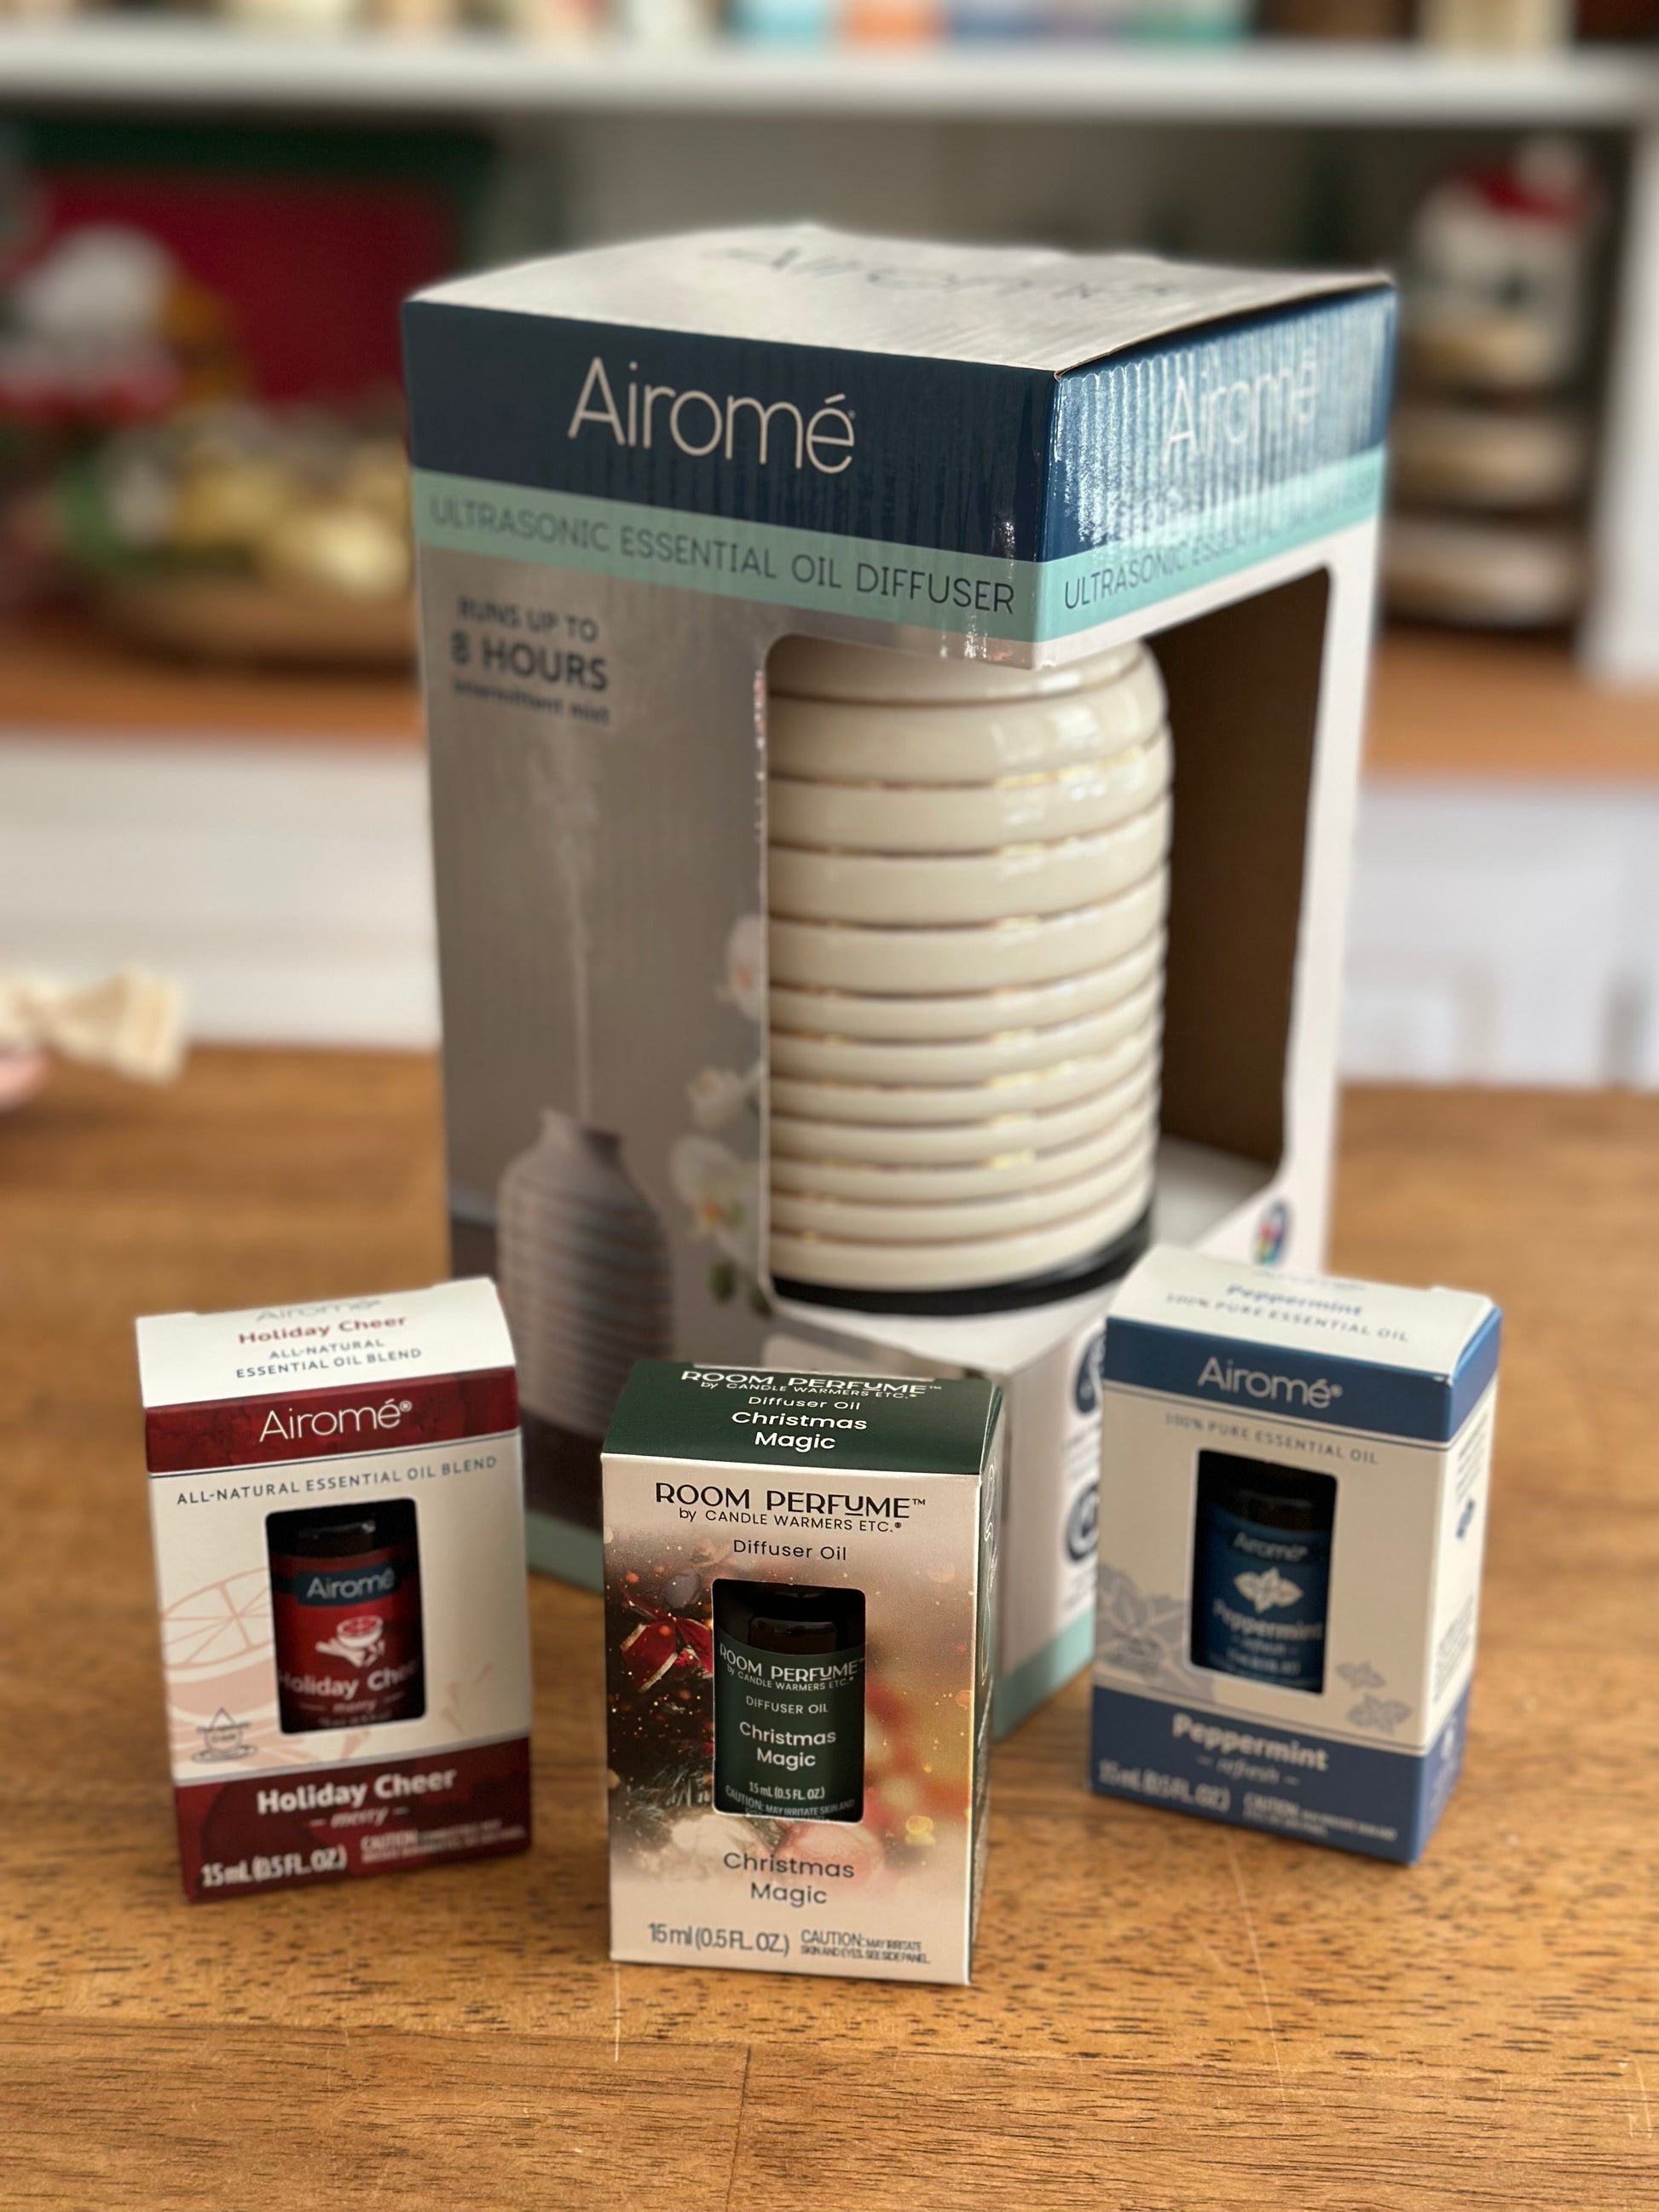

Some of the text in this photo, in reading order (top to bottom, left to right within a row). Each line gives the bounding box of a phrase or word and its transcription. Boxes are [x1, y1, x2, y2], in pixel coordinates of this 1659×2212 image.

[430, 494, 1014, 615] ULTRASONIC ESSENTIAL OIL DIFFUSER
[1064, 541, 1188, 609] ULTRASONIC
[458, 596, 598, 644] RUNS UP TO
[451, 629, 609, 692] 8 HOURS
[1226, 1283, 1364, 1317] Peppermint
[238, 1316, 408, 1345] Holiday Cheer
[1214, 1301, 1263, 1319] PURE
[1269, 1309, 1372, 1337] ESSENTIAL
[1377, 1326, 1409, 1343] OIL
[269, 1338, 385, 1360] ALL-NATURAL
[235, 1347, 423, 1379] ESSENTIAL OIL BLEND
[680, 1370, 776, 1385] ROOM
[700, 1381, 719, 1390] by
[725, 1383, 788, 1393] CANDLE
[793, 1386, 870, 1397] WARMERS
[748, 1395, 861, 1411] Diffuser Oil
[731, 1411, 869, 1430] Christmas
[754, 1431, 837, 1453] Magic
[1207, 1420, 1251, 1441] PURE
[1254, 1429, 1346, 1459] ESSENTIAL
[1350, 1449, 1379, 1465] OIL
[176, 1455, 498, 1505] ALL-NATURAL ESSENTIAL OIL BLEND
[655, 1481, 750, 1510] ROOM
[679, 1507, 697, 1523] by
[704, 1509, 768, 1526] CANDLE
[773, 1514, 853, 1532] WARMERS
[732, 1539, 847, 1562] Diffuser Oil
[719, 1642, 763, 1678] ROOM
[726, 1665, 737, 1678] by
[737, 1670, 773, 1689] CANDLE
[775, 1681, 826, 1692] WARMERS
[745, 1695, 830, 1715] DIFFUSER OIL
[738, 1721, 837, 1747] Christmas
[1171, 1712, 1330, 1773] Peppermint
[755, 1747, 817, 1771] Magic
[257, 1768, 457, 1816] Holiday Cheer
[725, 1784, 765, 1811] CAUTION:
[765, 1804, 783, 1816] MAY
[783, 1806, 819, 1816] IRRITATE
[819, 1802, 839, 1815] SKIN
[774, 1786, 791, 1800] (0.5
[806, 1786, 826, 1800] OZ.)
[330, 1805, 390, 1829] merry
[723, 1851, 855, 1880] Christmas
[750, 1881, 828, 1909] Magic
[695, 1926, 727, 1952] (0.5
[800, 1928, 923, 1953] CAUTION: MAY IRRITATE
[800, 1944, 822, 1956] SKIN
[820, 1946, 841, 1958] AND
